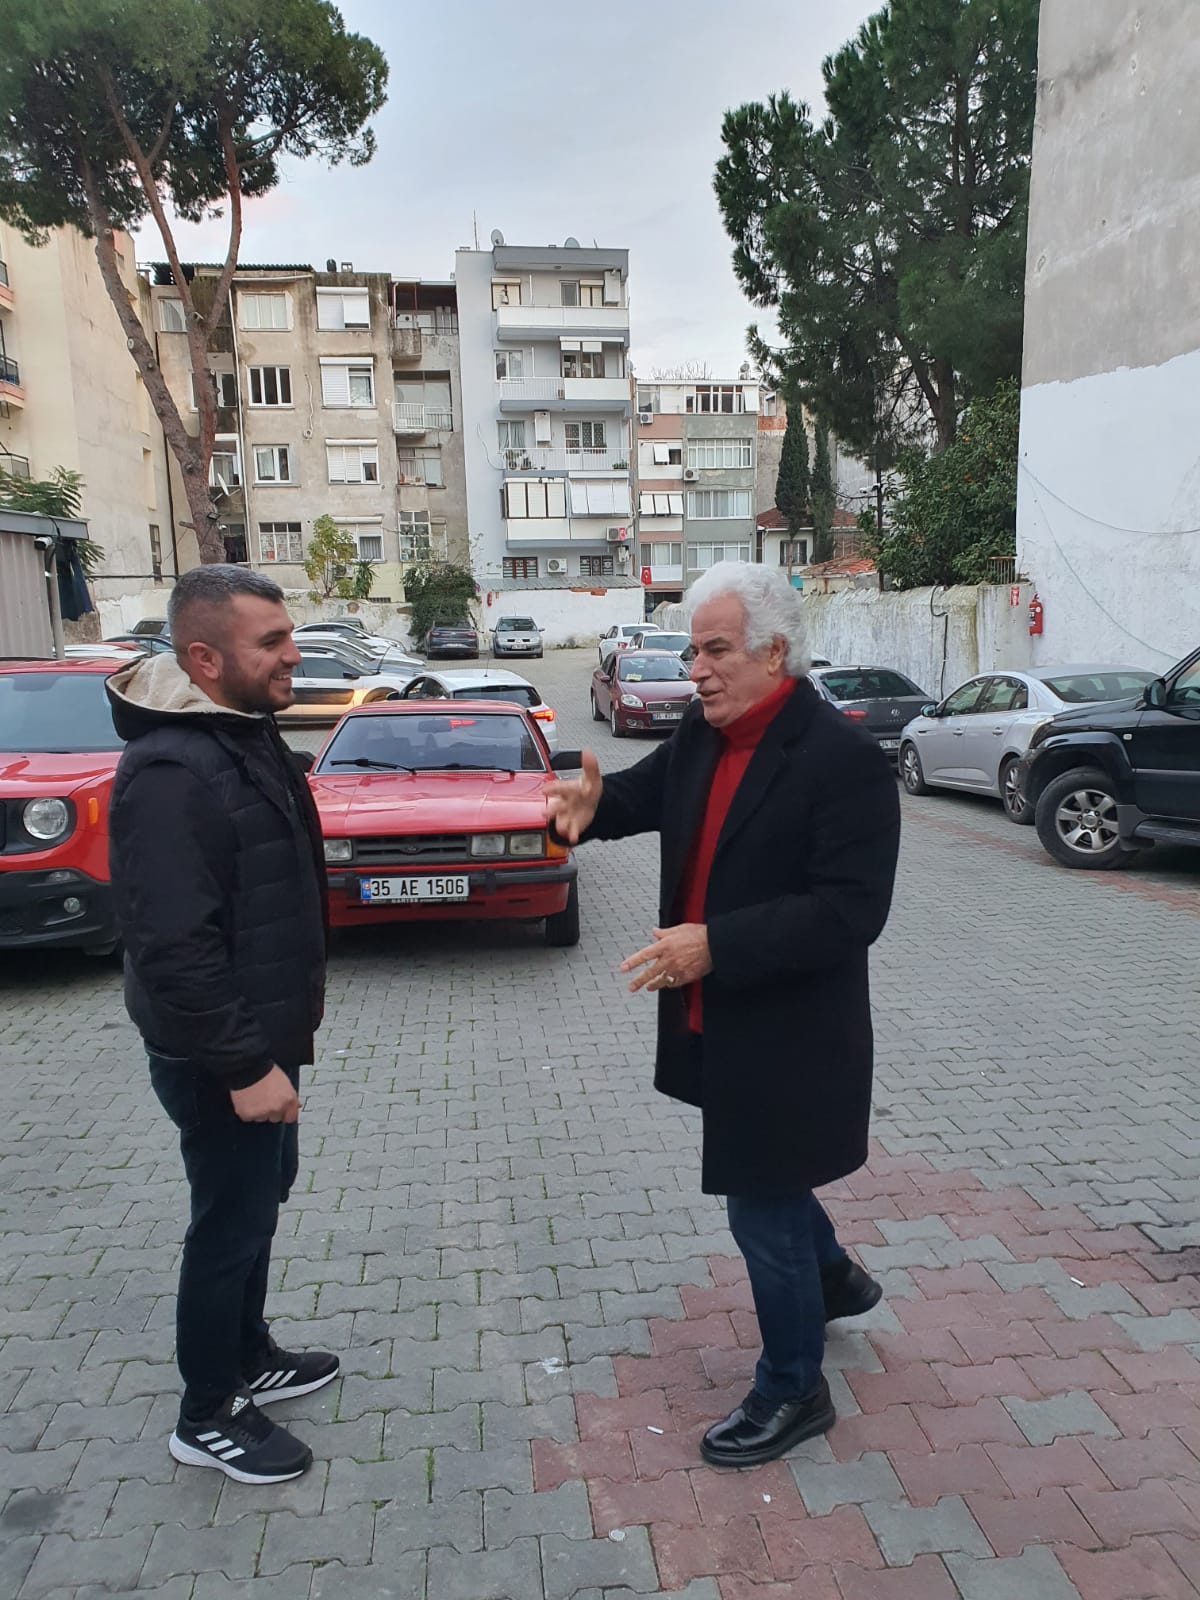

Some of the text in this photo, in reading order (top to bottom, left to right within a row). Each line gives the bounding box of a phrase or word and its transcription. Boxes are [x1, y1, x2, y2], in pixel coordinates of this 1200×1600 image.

[371, 878, 464, 897] 35 AE 1506
